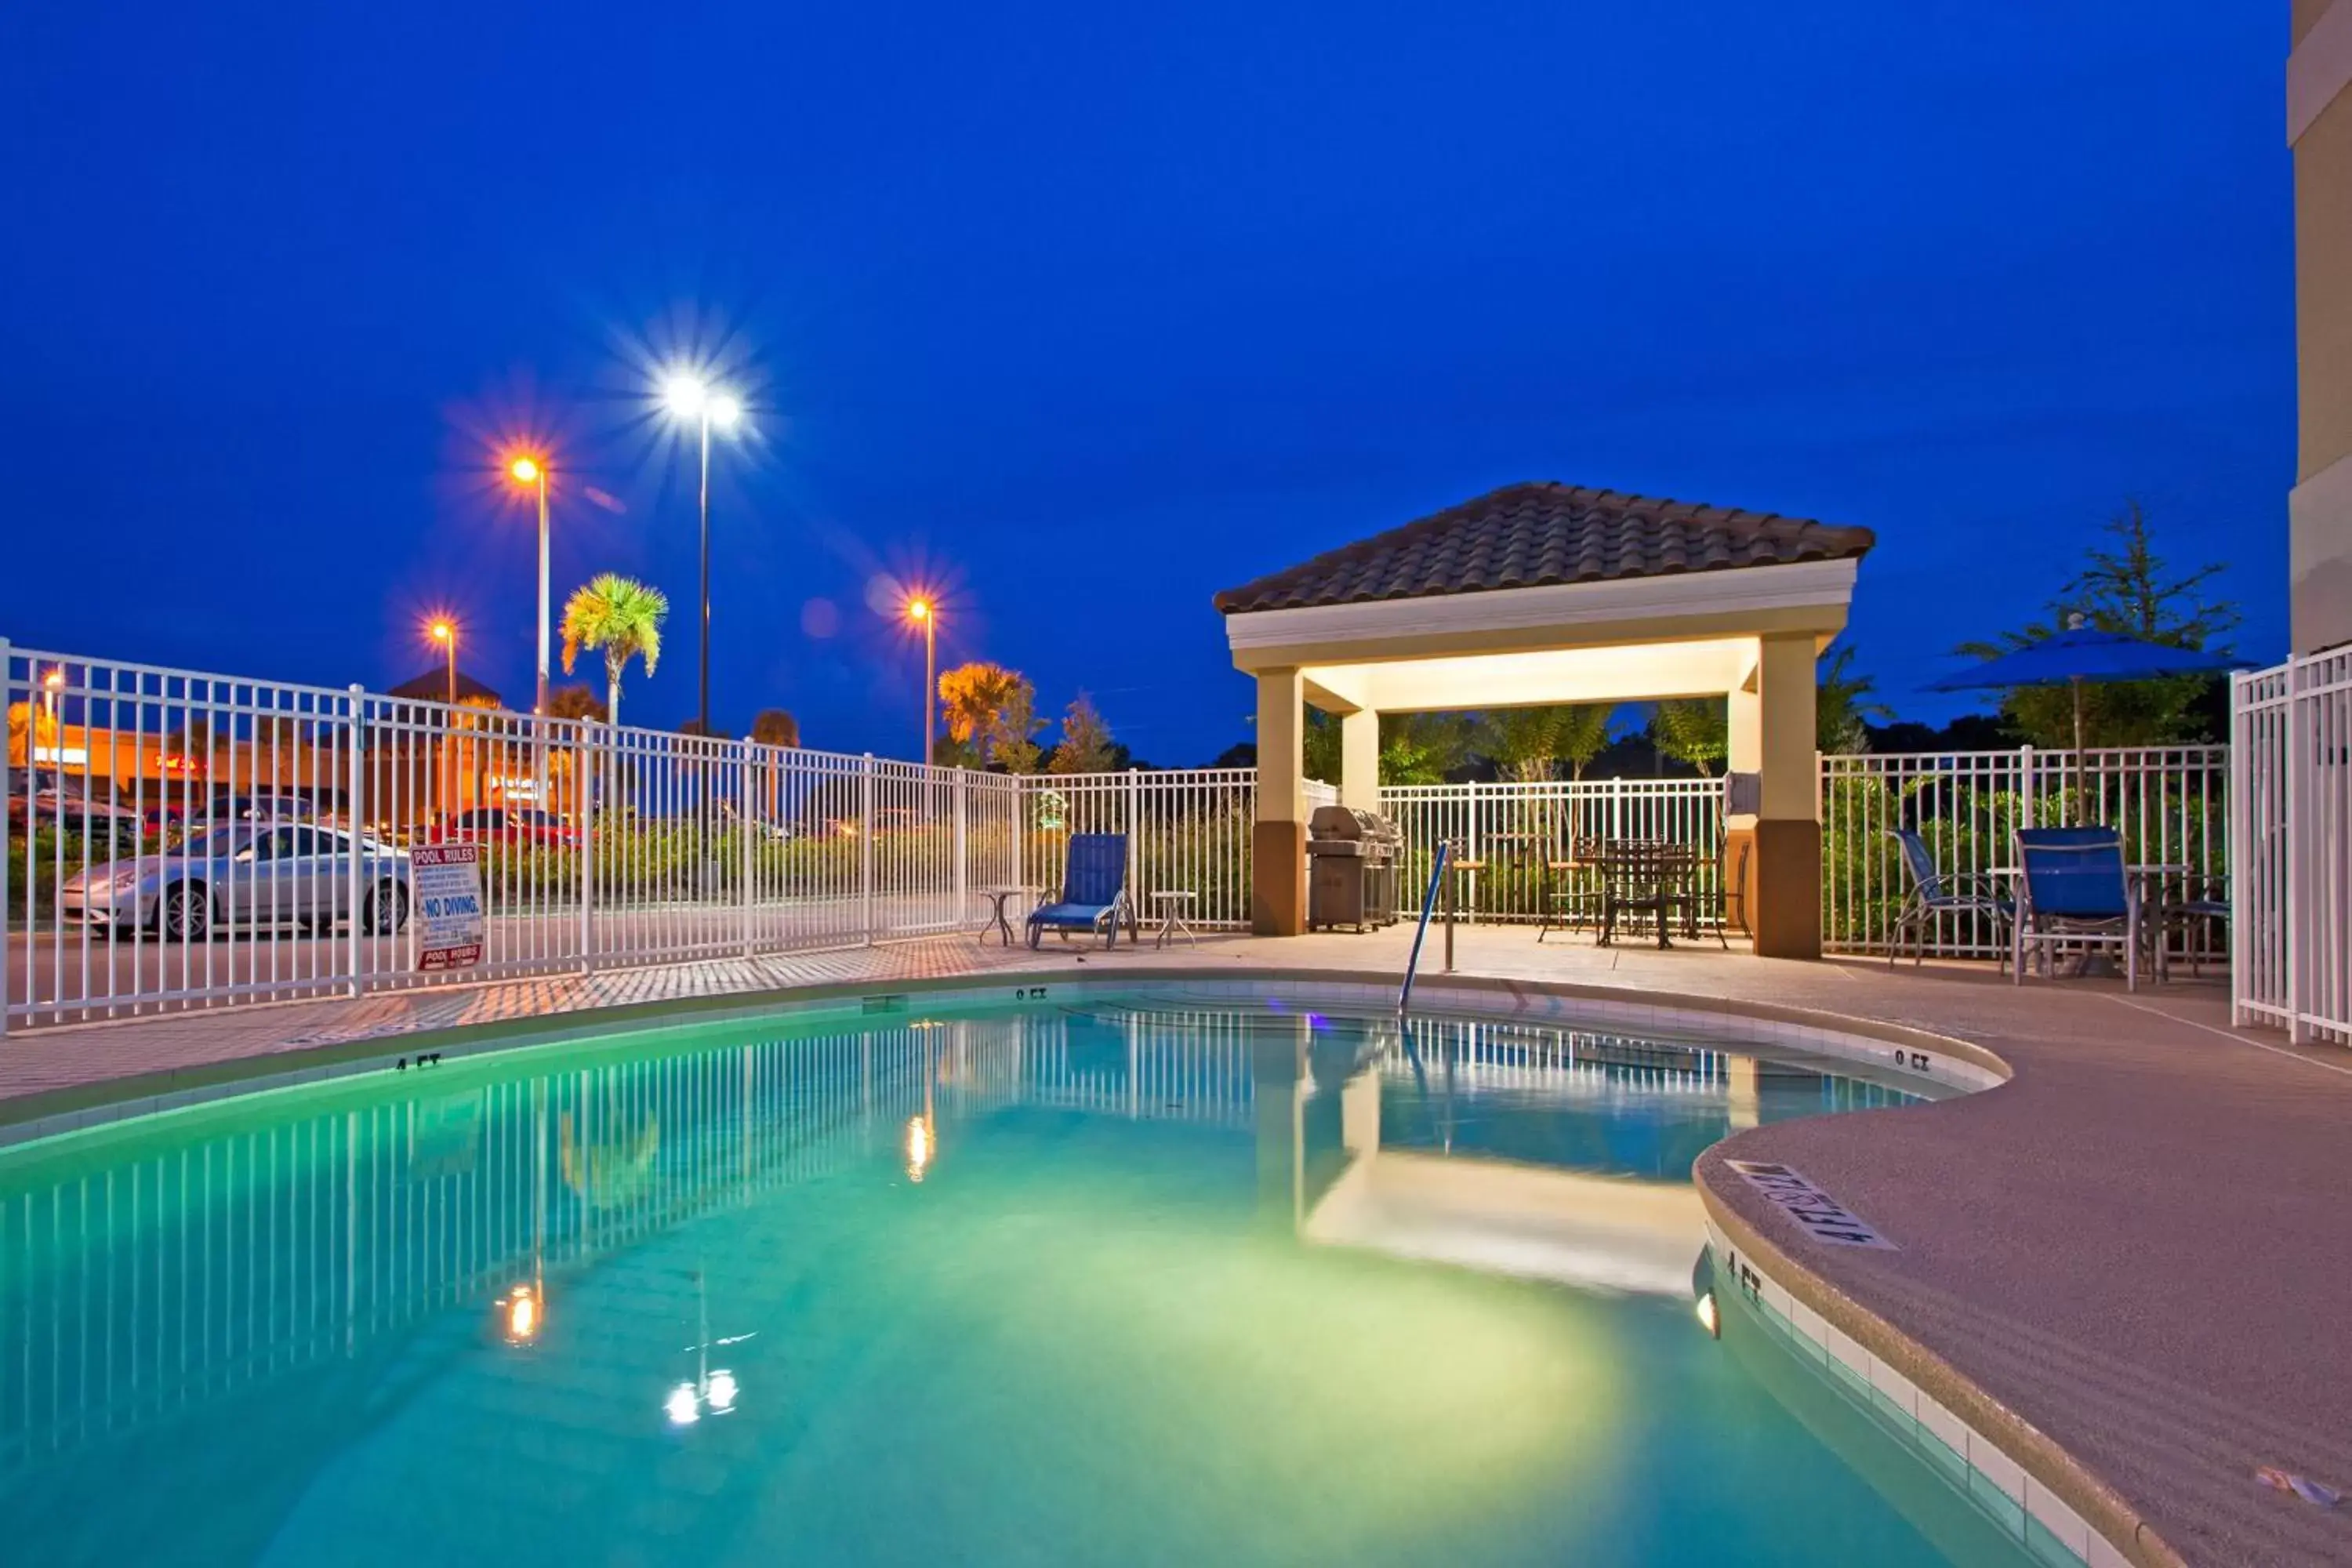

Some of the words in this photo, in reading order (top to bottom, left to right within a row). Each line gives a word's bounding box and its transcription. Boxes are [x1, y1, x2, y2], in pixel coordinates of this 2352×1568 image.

[415, 851, 441, 863] POOL
[444, 848, 474, 862] RULES
[426, 898, 441, 917] NO
[417, 1053, 441, 1066] FT
[1741, 1262, 1761, 1303] FT
